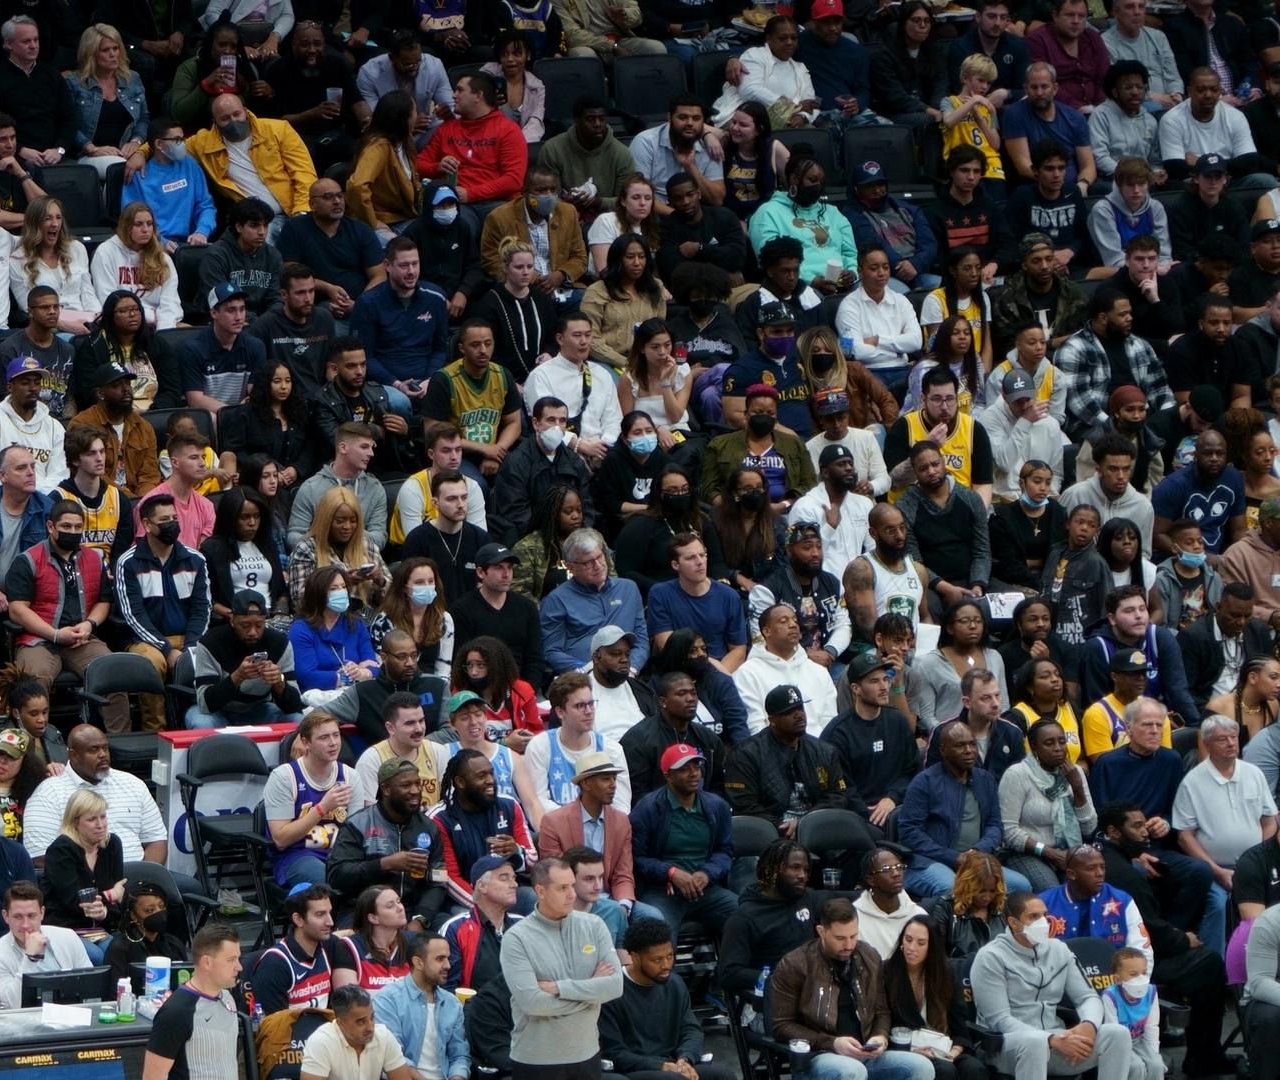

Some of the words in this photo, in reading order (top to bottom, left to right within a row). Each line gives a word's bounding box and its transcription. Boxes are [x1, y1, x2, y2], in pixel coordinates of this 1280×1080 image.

[972, 127, 982, 146] 6
[460, 409, 497, 426] IRISH
[246, 572, 257, 588] 8
[289, 978, 331, 999] washington
